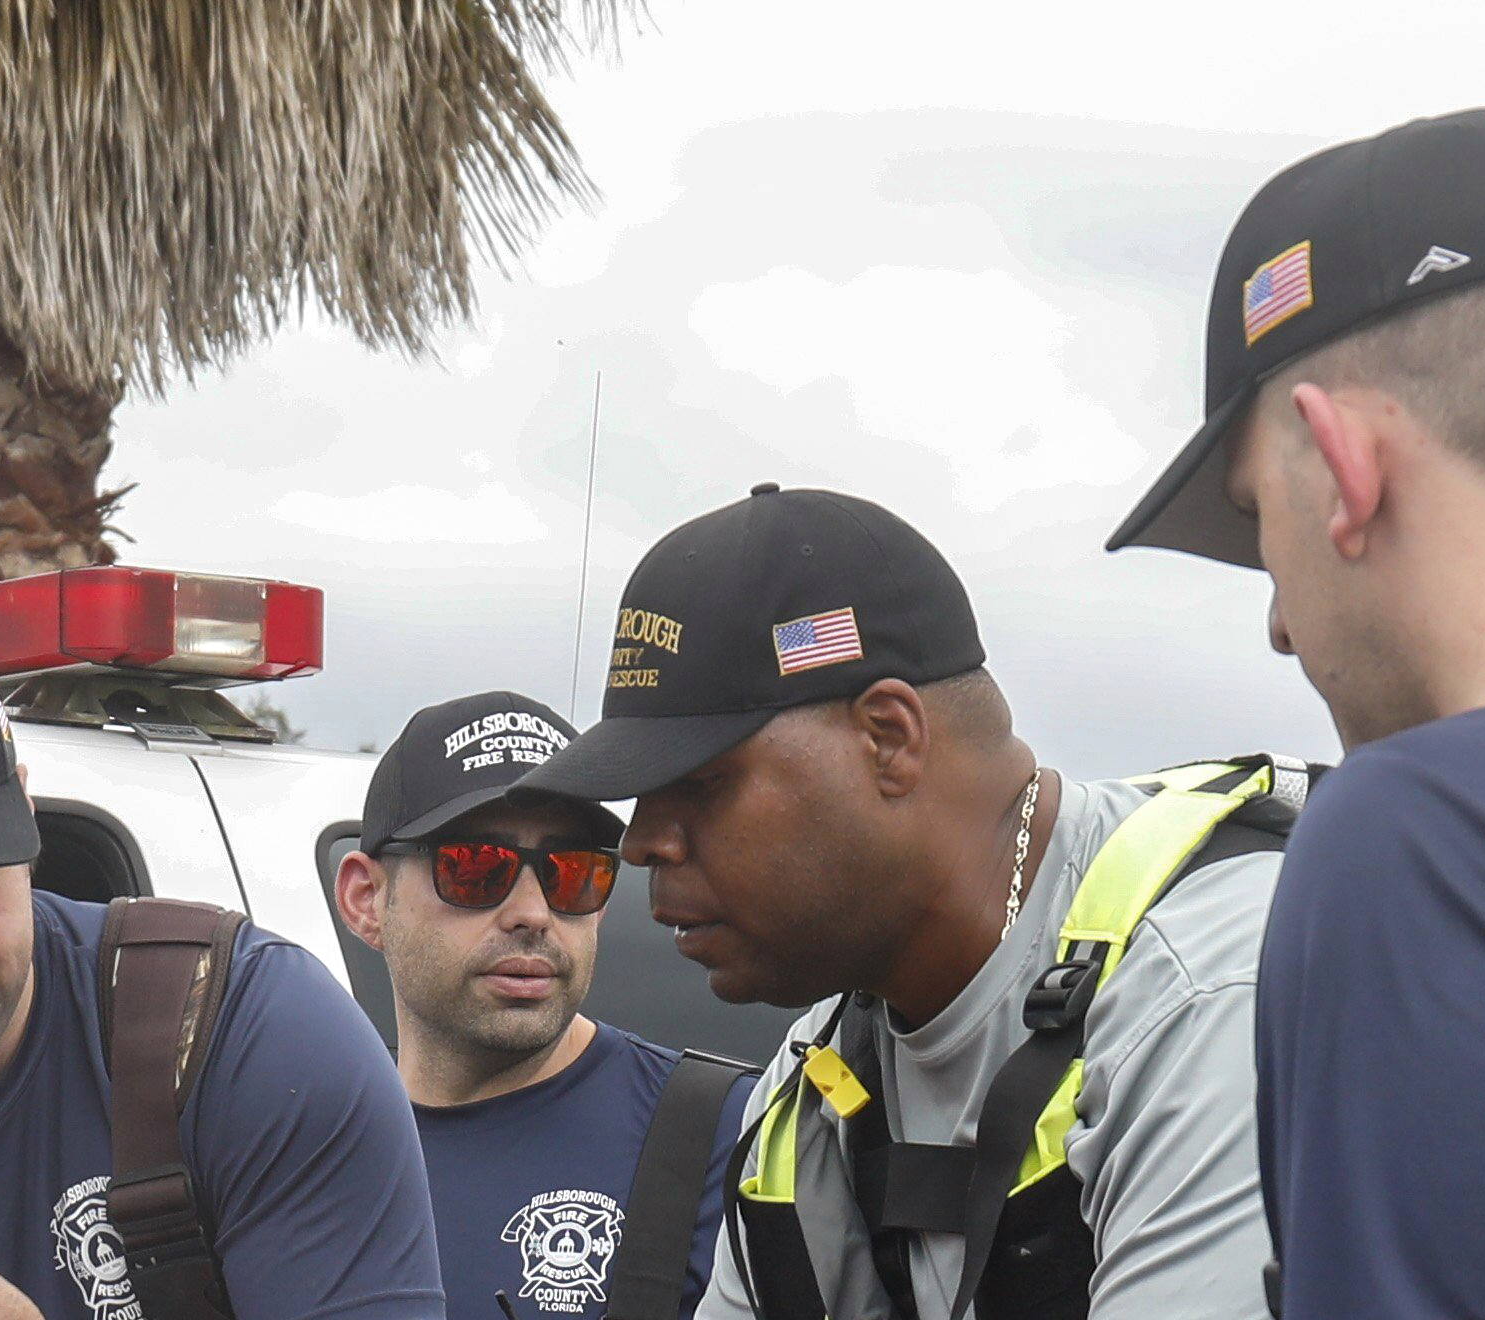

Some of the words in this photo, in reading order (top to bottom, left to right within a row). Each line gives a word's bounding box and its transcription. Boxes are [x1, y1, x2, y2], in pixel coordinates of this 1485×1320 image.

[444, 711, 571, 758] HILLSBOROUG
[481, 735, 554, 756] COUNTY
[462, 751, 505, 772] FIRE
[54, 1176, 112, 1221] HILLSBOROU
[530, 1189, 617, 1212] HILLSBOROUGH
[76, 1207, 107, 1231] FIRE
[552, 1210, 589, 1224] FIRE
[539, 1264, 589, 1280] RESCUE
[97, 1280, 132, 1297] RESC
[535, 1288, 589, 1304] COUNTY
[539, 1302, 584, 1314] FLORIDA
